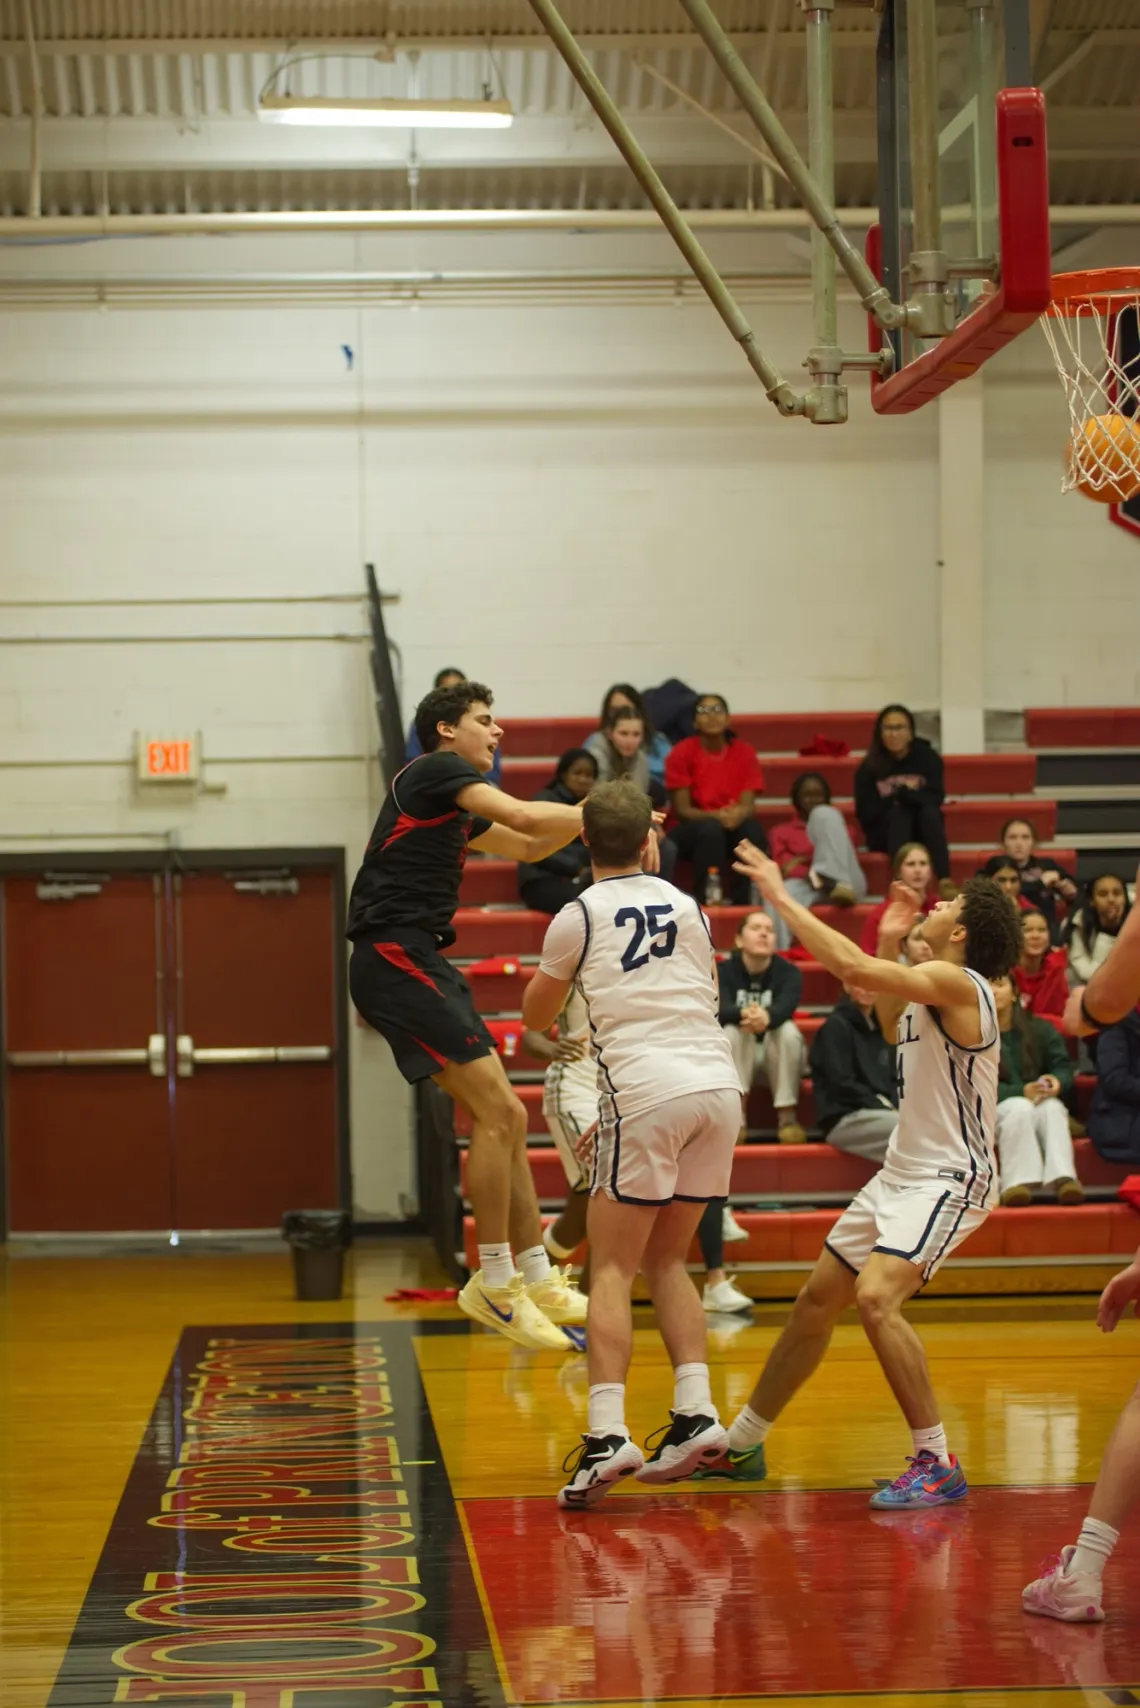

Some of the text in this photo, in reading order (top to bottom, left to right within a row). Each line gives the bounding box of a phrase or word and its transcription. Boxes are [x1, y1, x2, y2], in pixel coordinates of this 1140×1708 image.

[147, 741, 191, 776] EXIT
[614, 904, 678, 973] 25
[160, 1337, 409, 1513] PRINCETON
[147, 1512, 416, 1554] of
